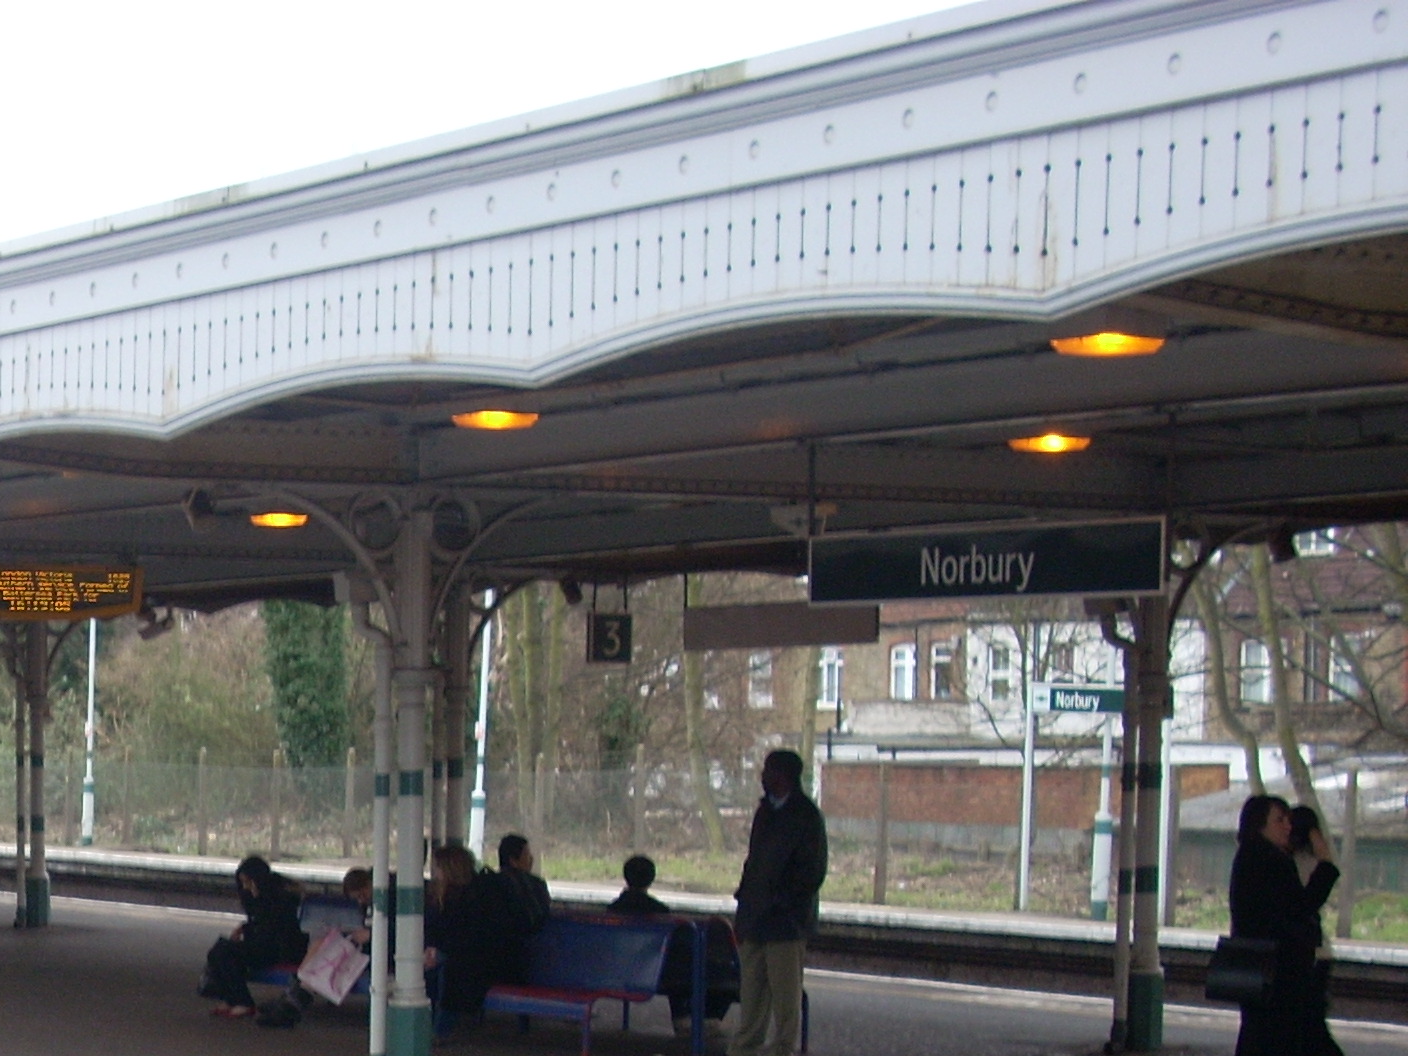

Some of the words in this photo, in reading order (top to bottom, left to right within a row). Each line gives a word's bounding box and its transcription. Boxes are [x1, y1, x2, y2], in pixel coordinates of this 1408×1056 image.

[34, 571, 73, 582] Victoria
[920, 545, 1035, 592] Norbury
[116, 582, 129, 592] of
[602, 620, 621, 657] 3
[1055, 690, 1100, 713] Norbury
